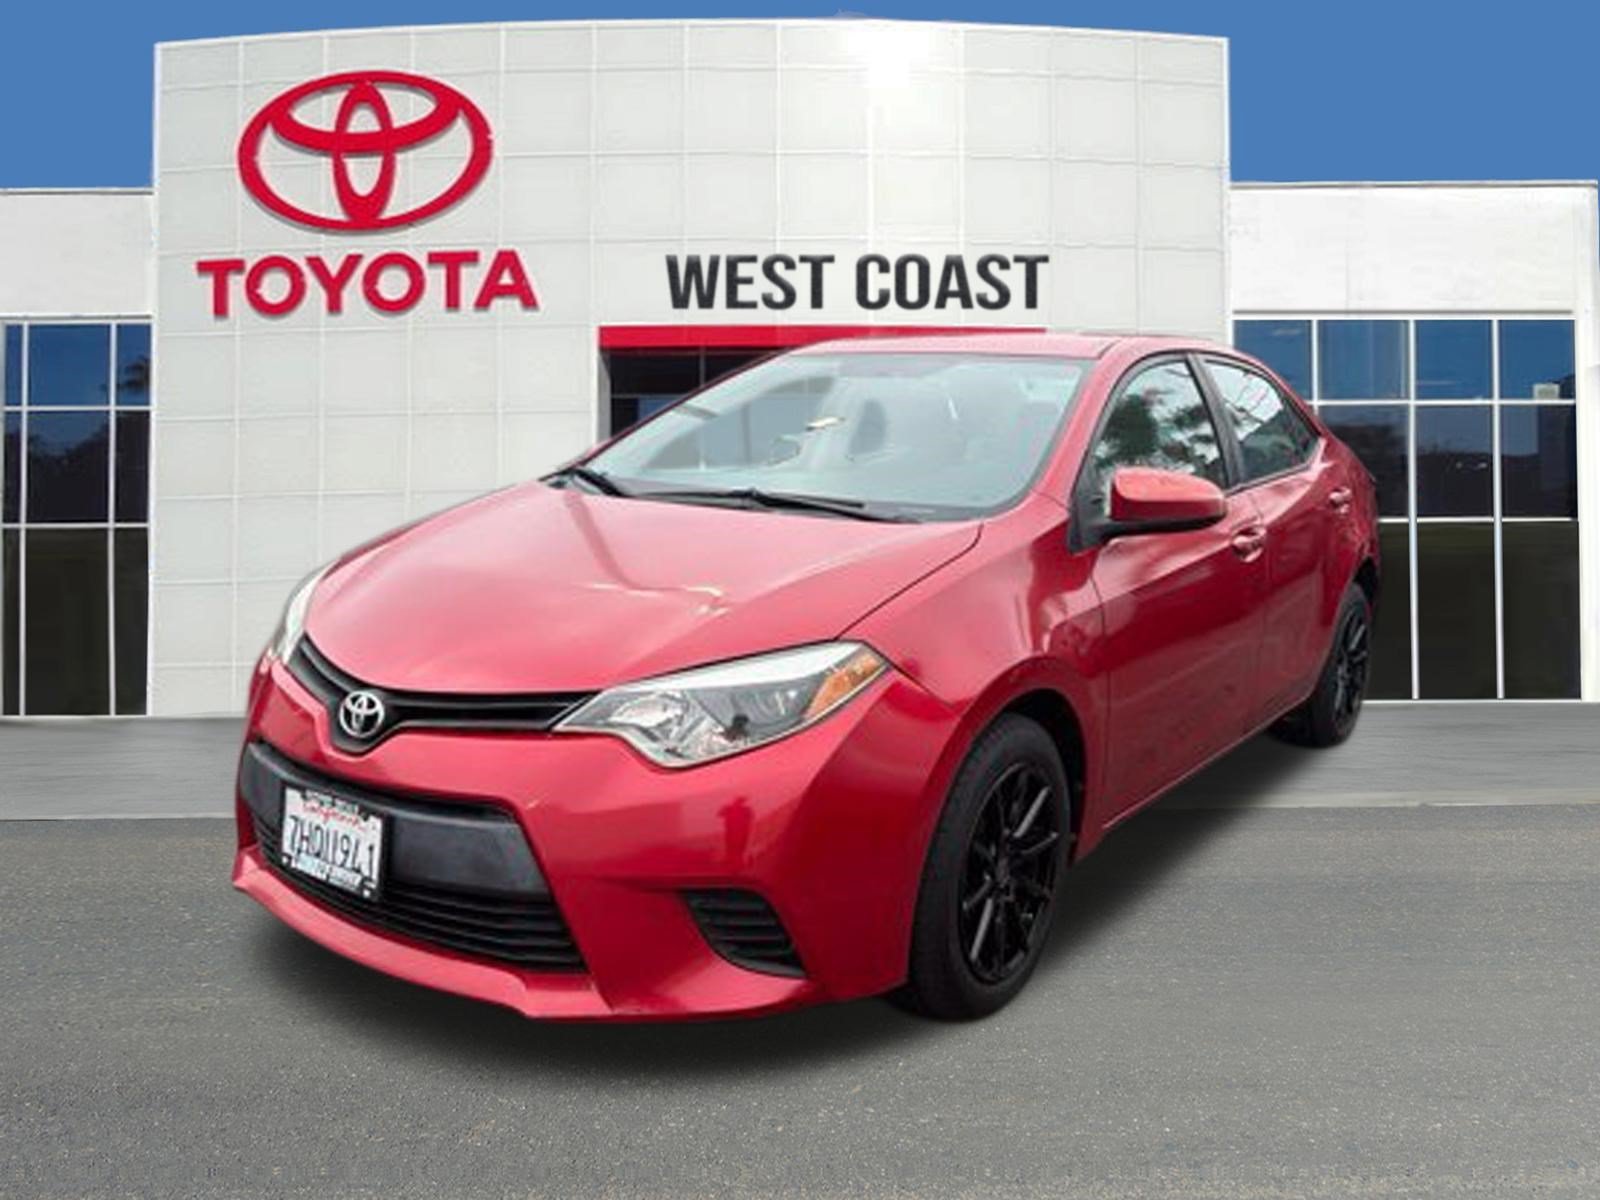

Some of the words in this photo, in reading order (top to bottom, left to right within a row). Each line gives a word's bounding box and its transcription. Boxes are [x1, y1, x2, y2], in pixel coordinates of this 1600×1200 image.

[195, 249, 538, 317] TOYOTA
[665, 253, 835, 310] WEST
[855, 253, 1050, 310] COAST
